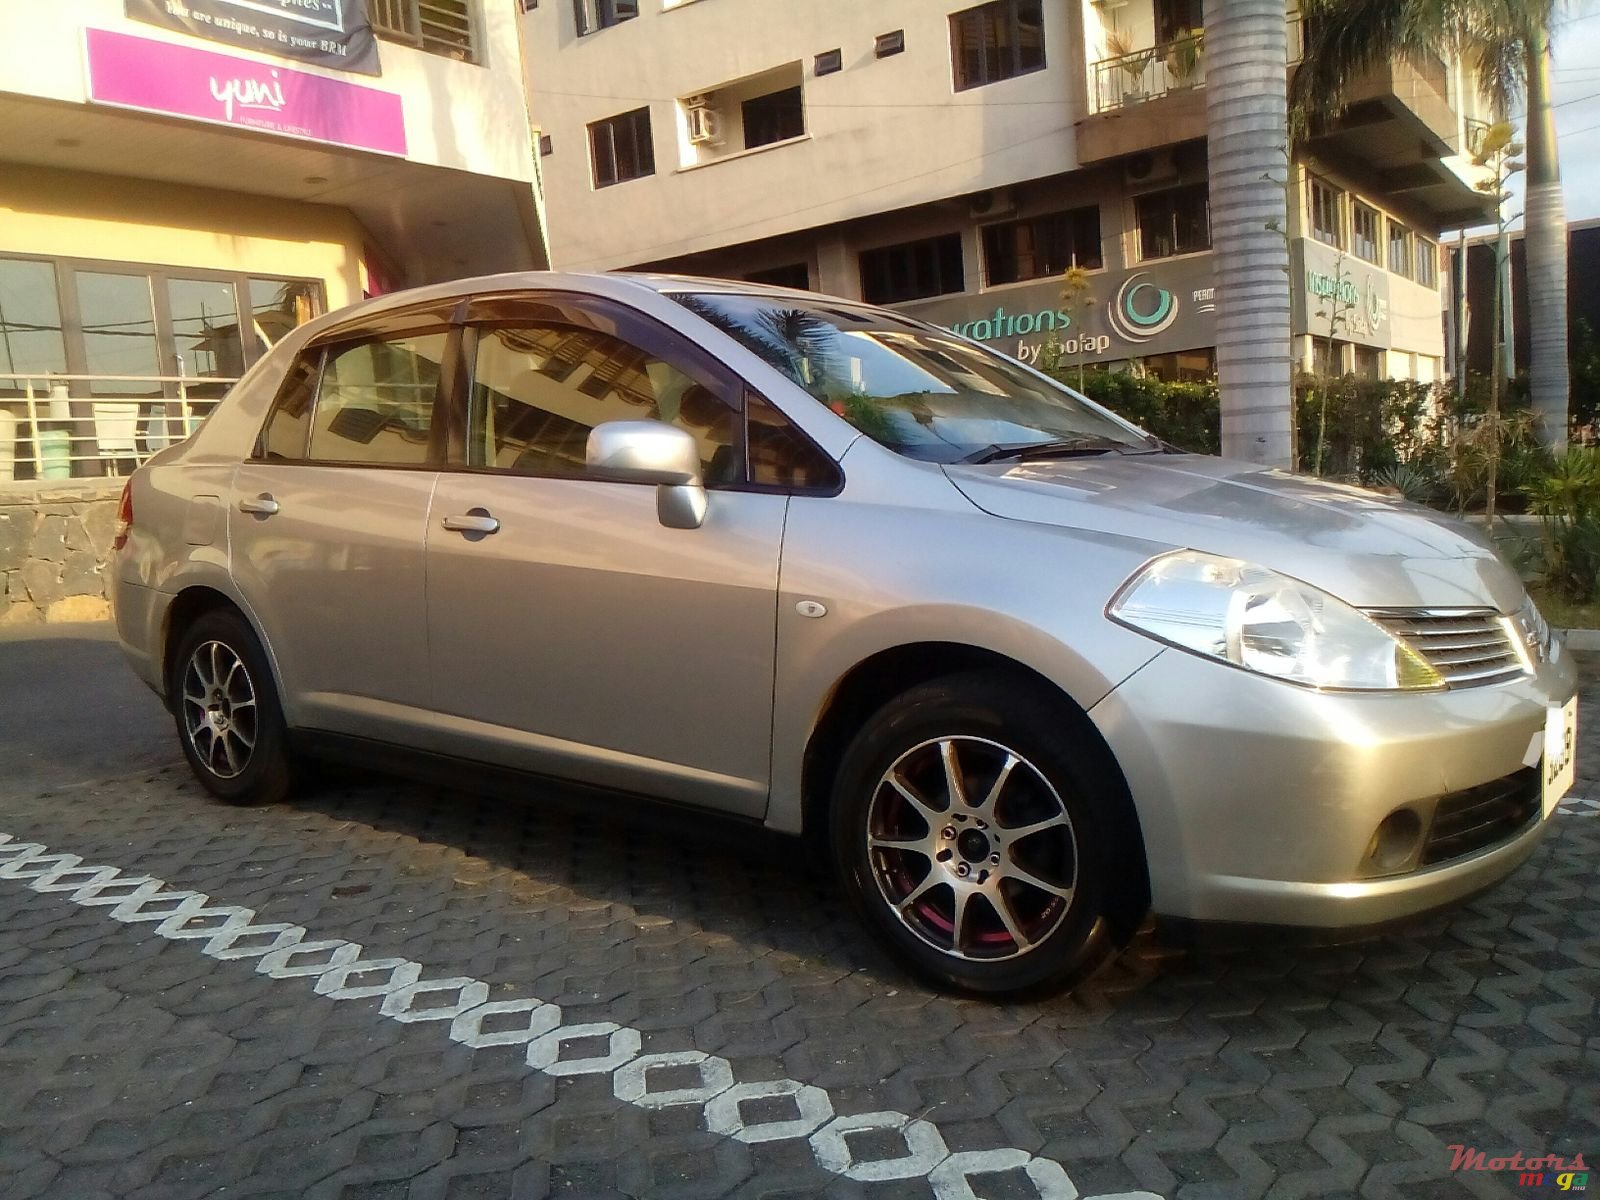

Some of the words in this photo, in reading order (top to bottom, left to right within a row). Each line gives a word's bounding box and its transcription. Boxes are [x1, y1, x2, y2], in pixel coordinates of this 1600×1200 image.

[192, 10, 212, 24] are
[213, 16, 260, 35] unique,
[262, 28, 275, 40] so
[277, 29, 288, 42] is
[290, 36, 317, 48] your
[209, 69, 286, 121] yuni
[1017, 339, 1042, 365] by
